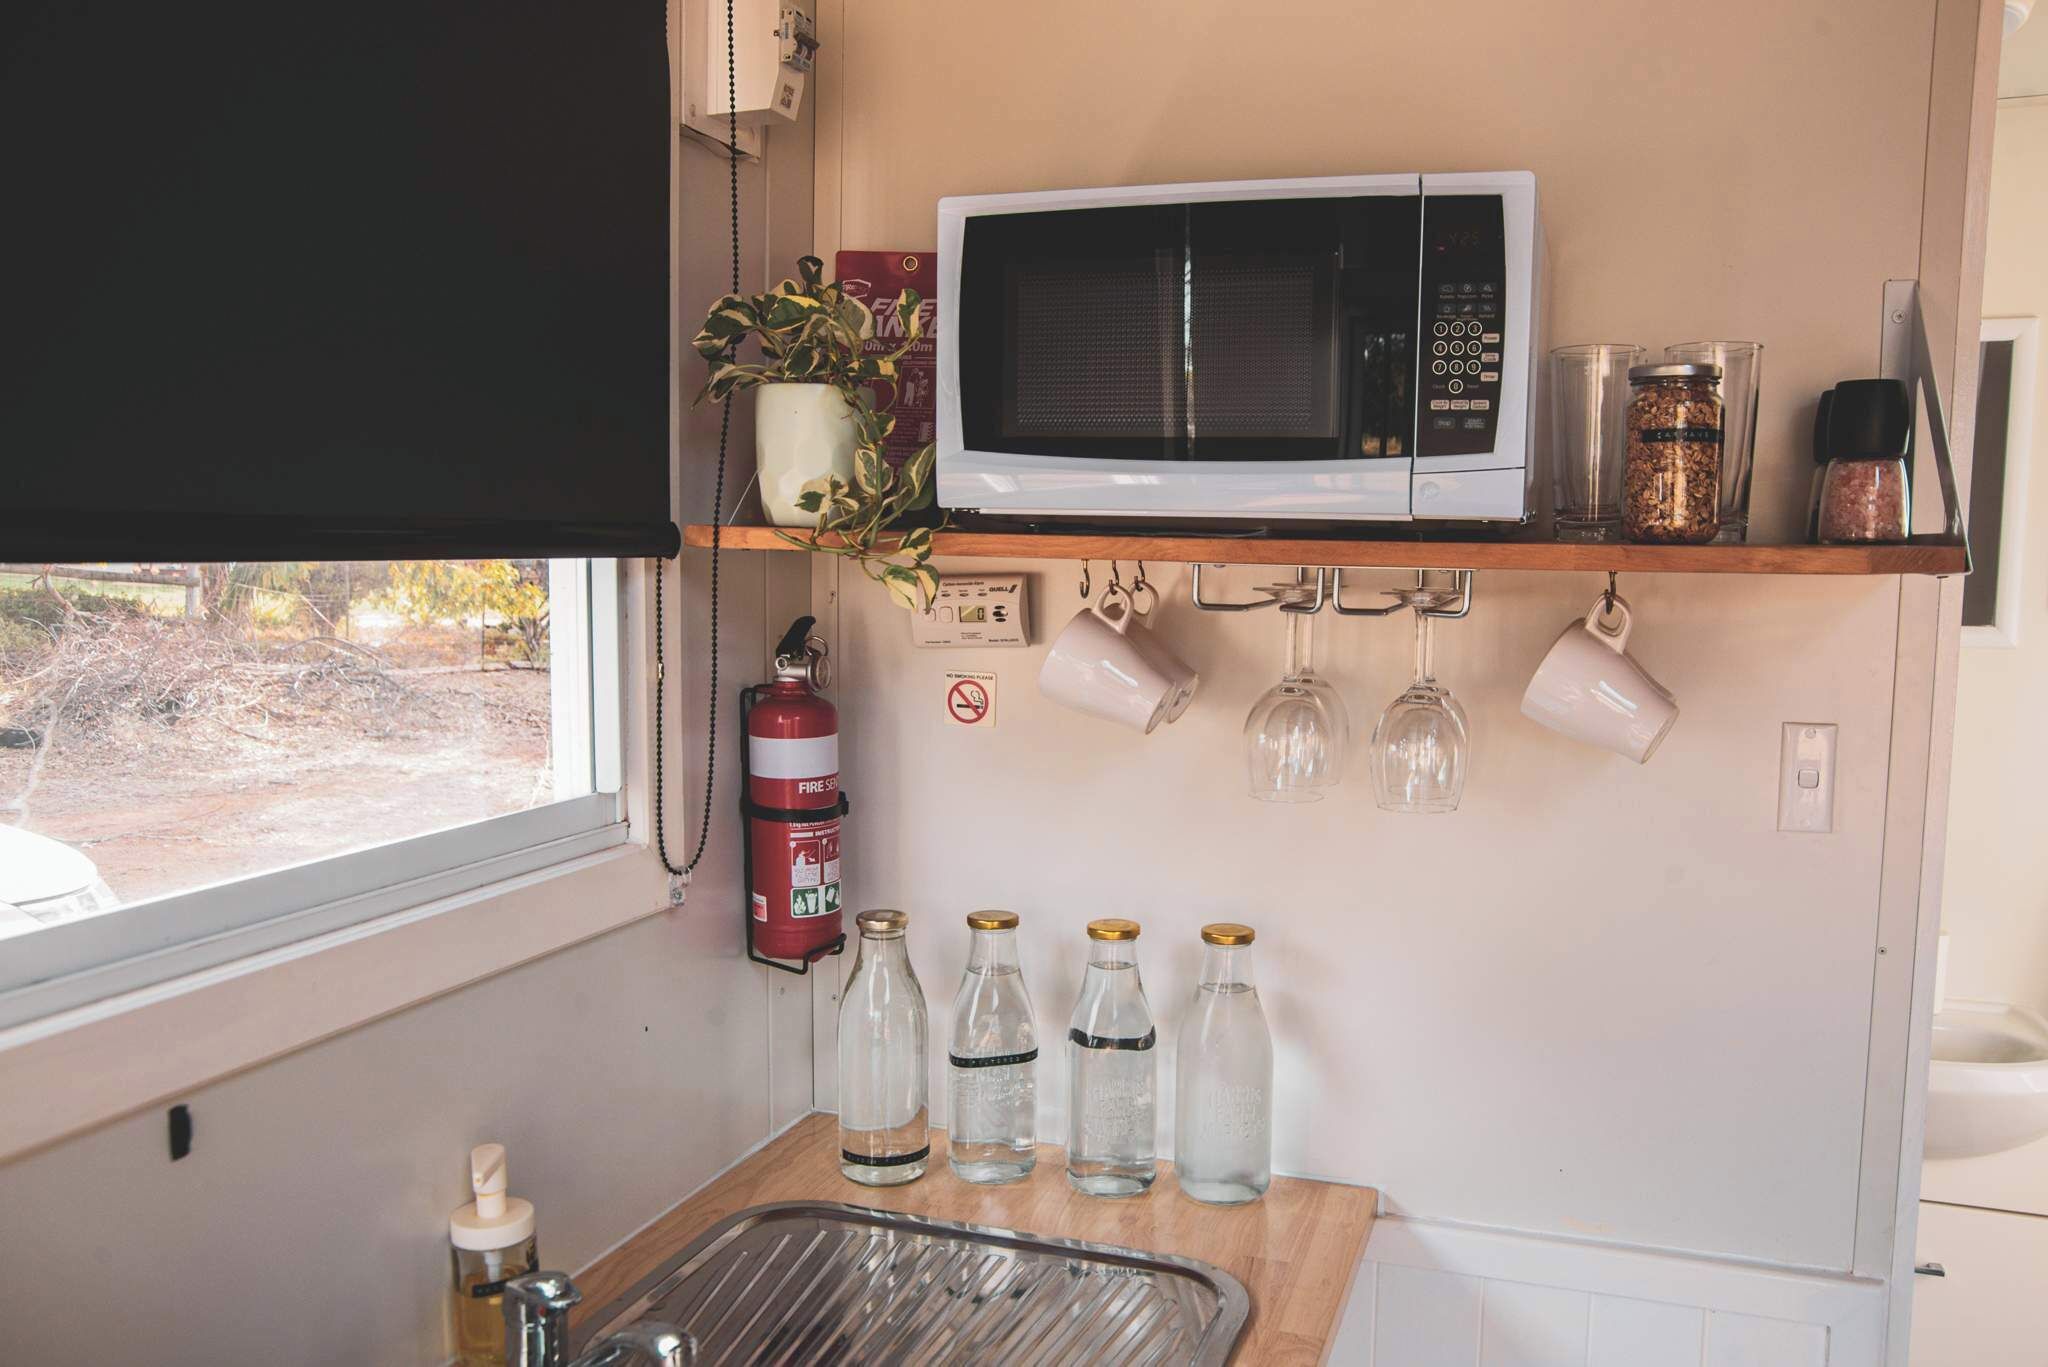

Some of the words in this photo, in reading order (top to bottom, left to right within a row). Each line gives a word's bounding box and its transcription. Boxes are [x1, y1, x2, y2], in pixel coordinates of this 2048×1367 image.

[871, 298, 937, 318] FIE
[977, 607, 985, 621] 0
[798, 780, 824, 794] FIRE
